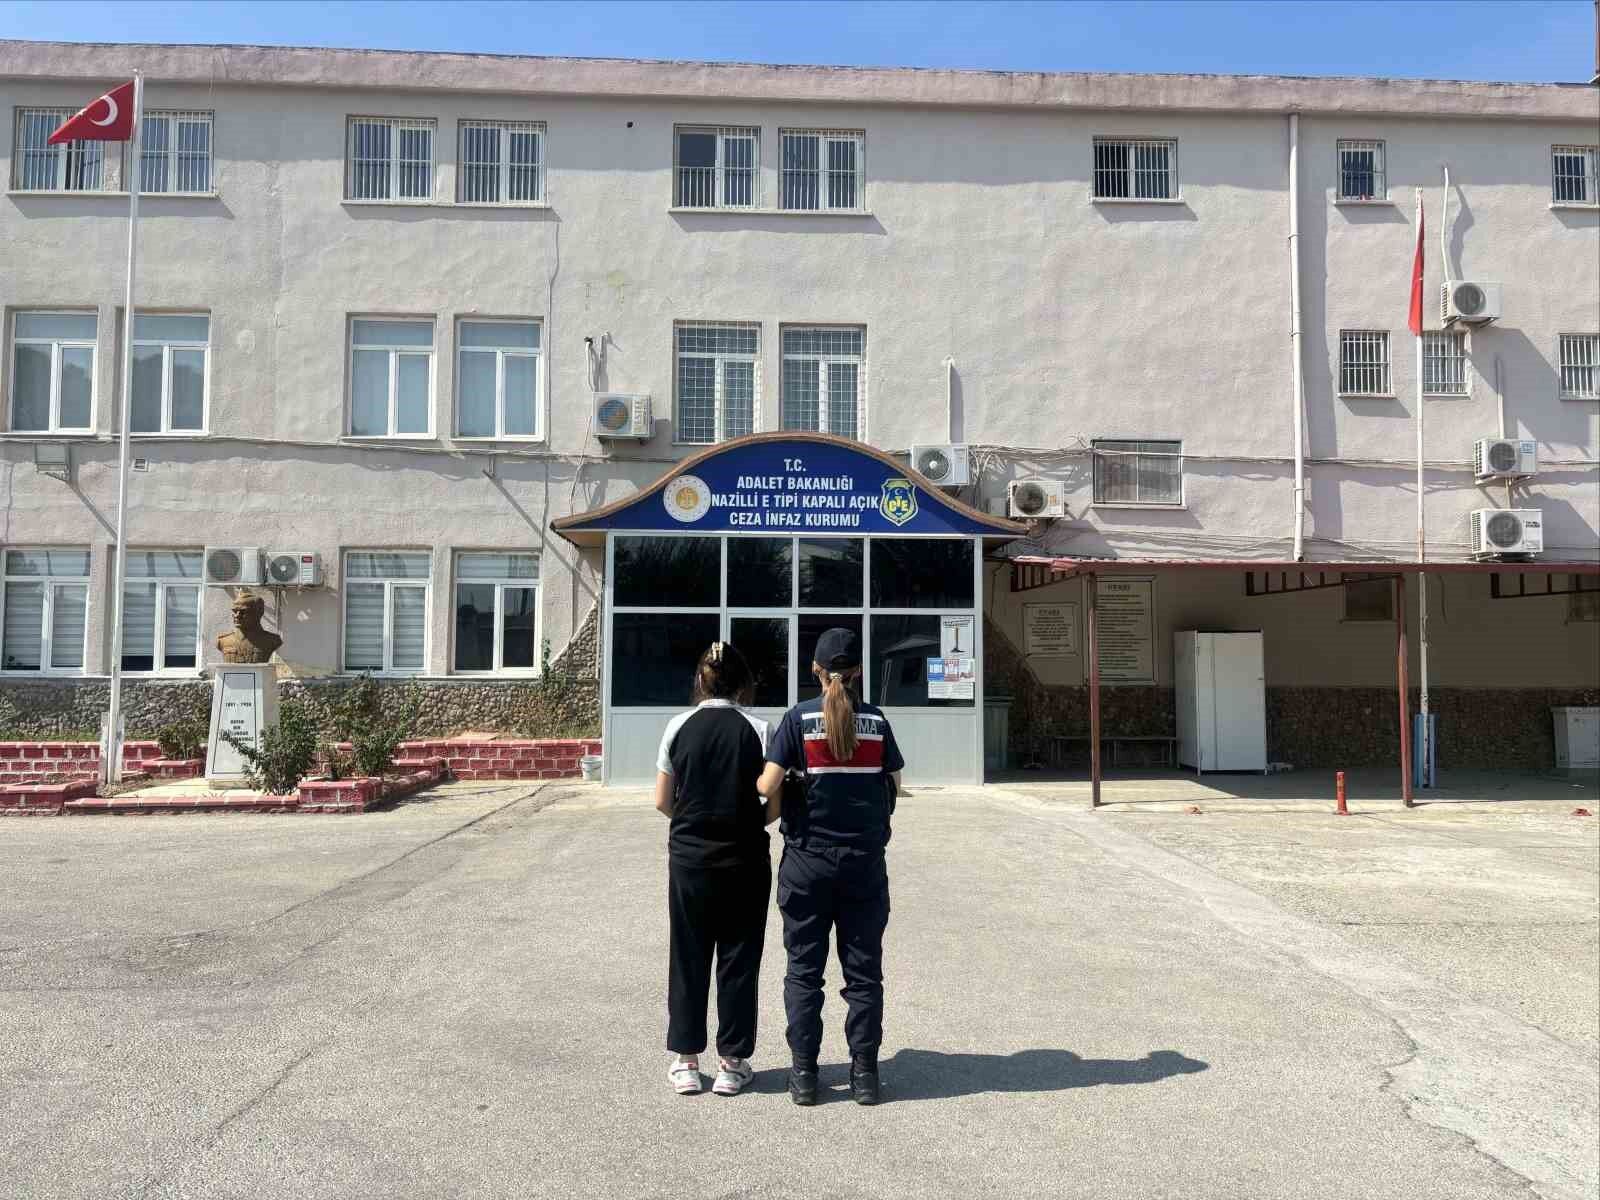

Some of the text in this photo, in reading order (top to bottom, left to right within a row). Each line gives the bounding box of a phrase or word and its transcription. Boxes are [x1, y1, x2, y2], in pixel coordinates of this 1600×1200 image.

[784, 459, 807, 472] T.C.
[737, 475, 853, 491] ADALET BAKANLIĞI
[711, 492, 879, 511] NAZİLLİ E TİPİ KAPALI AÇIK
[729, 510, 860, 527] CEZA İNFAZ KURUMU
